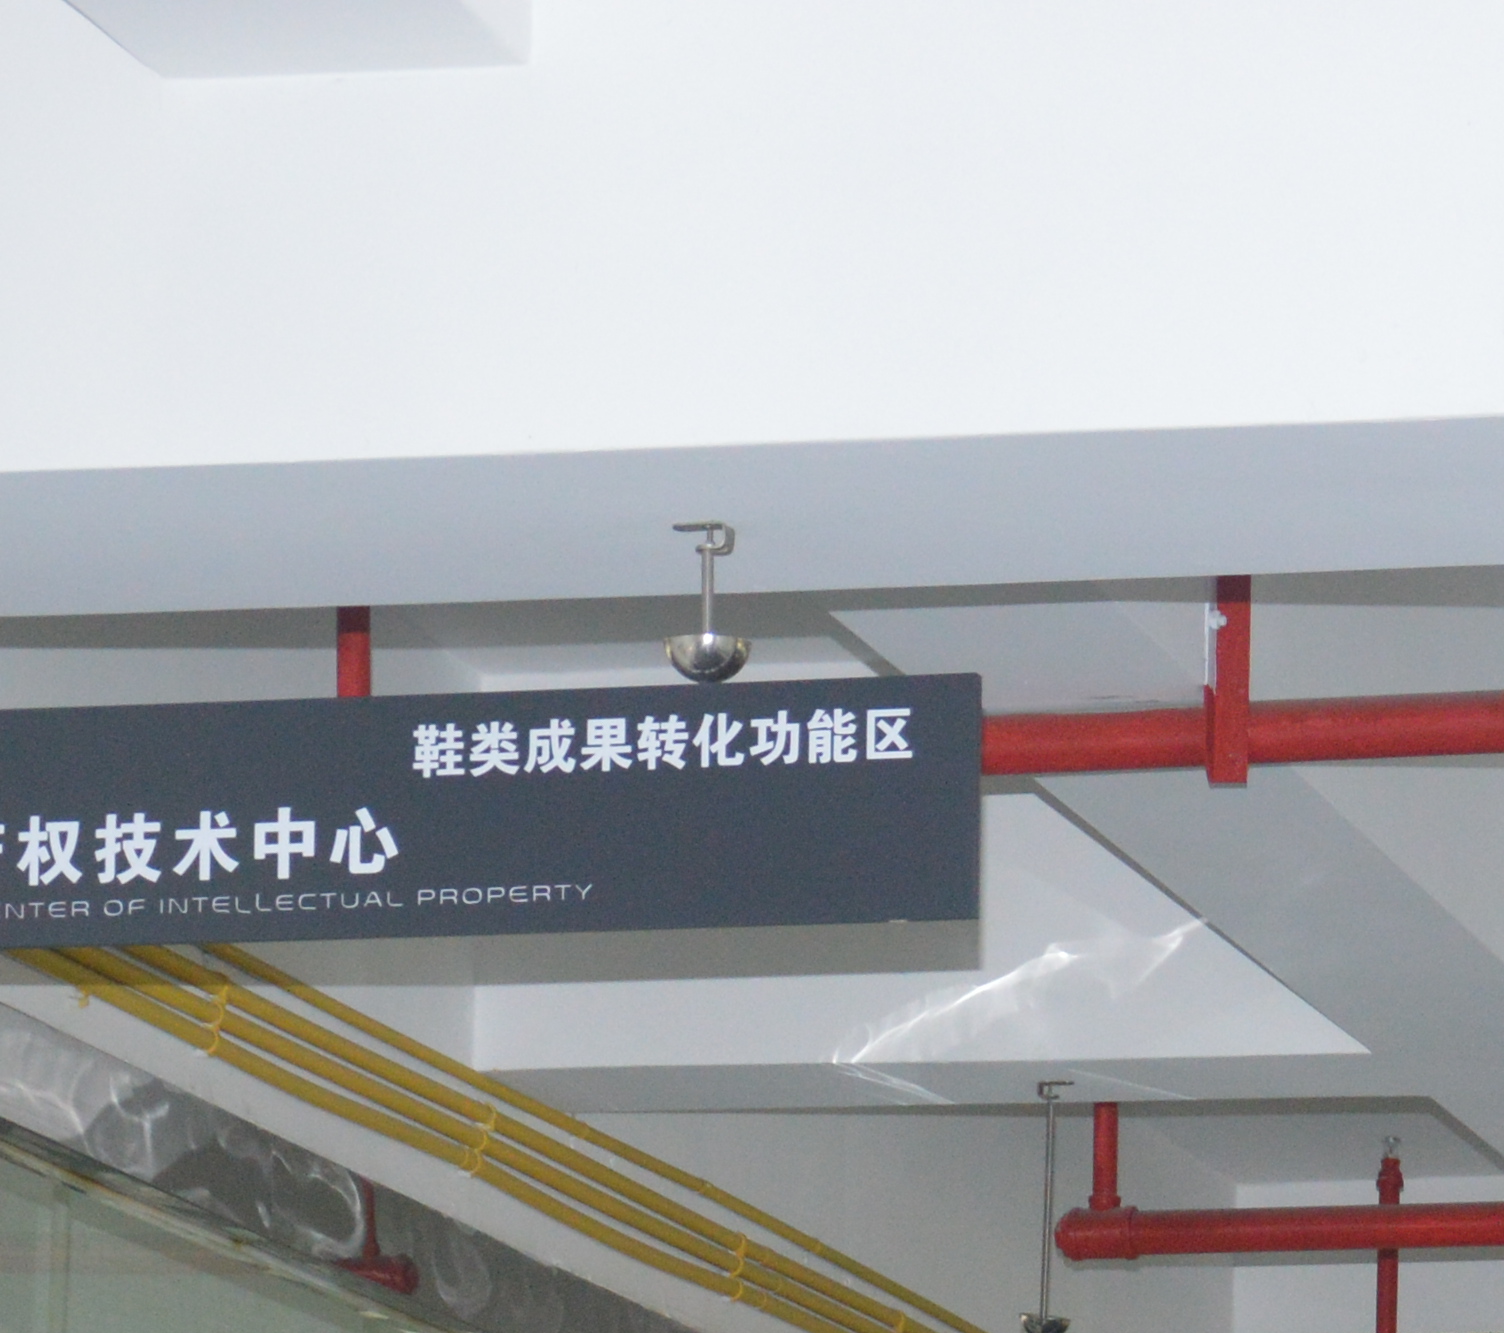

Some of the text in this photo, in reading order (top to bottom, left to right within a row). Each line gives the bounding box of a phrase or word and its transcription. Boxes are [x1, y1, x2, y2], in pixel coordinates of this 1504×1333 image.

[413, 708, 913, 779] 鞋类成果转化功能区
[103, 898, 146, 917] OF
[159, 890, 403, 915] INTELLECTUAL
[417, 883, 593, 906] PROPERTY
